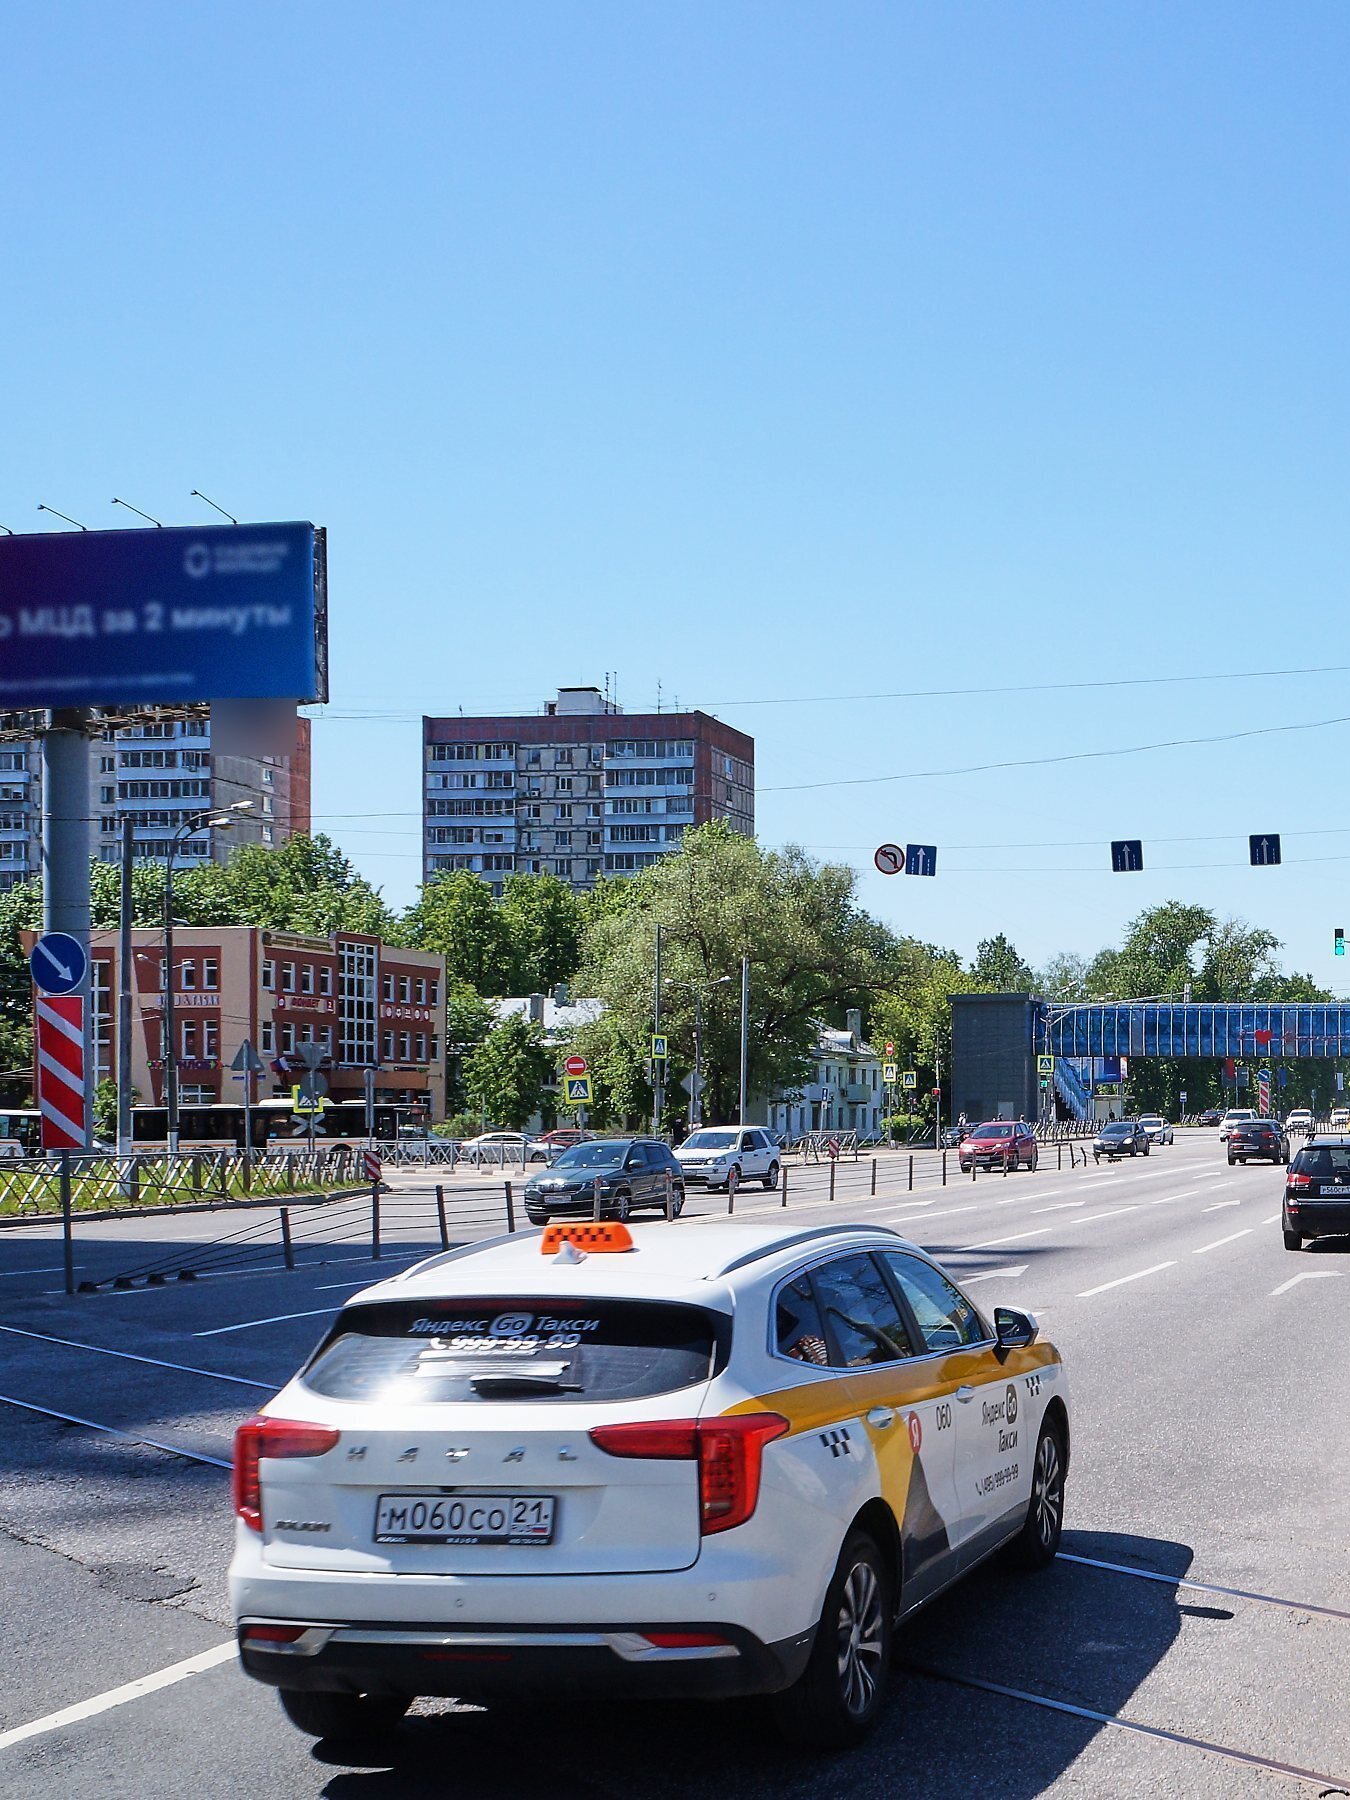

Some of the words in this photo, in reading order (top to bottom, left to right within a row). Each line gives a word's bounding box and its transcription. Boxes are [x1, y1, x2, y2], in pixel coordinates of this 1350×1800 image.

[18, 606, 95, 638] МЦД
[144, 602, 164, 632] 2
[170, 604, 292, 636] минуты
[408, 1318, 488, 1334] Яндекс
[497, 1317, 526, 1331] Go
[536, 1316, 600, 1332] Такси
[935, 1403, 951, 1431] 060
[982, 1401, 1005, 1427] Яндекс
[999, 1429, 1018, 1453] Такси
[347, 1446, 579, 1463] HAVAL
[388, 1502, 504, 1531] М060СО
[514, 1501, 543, 1523] 21
